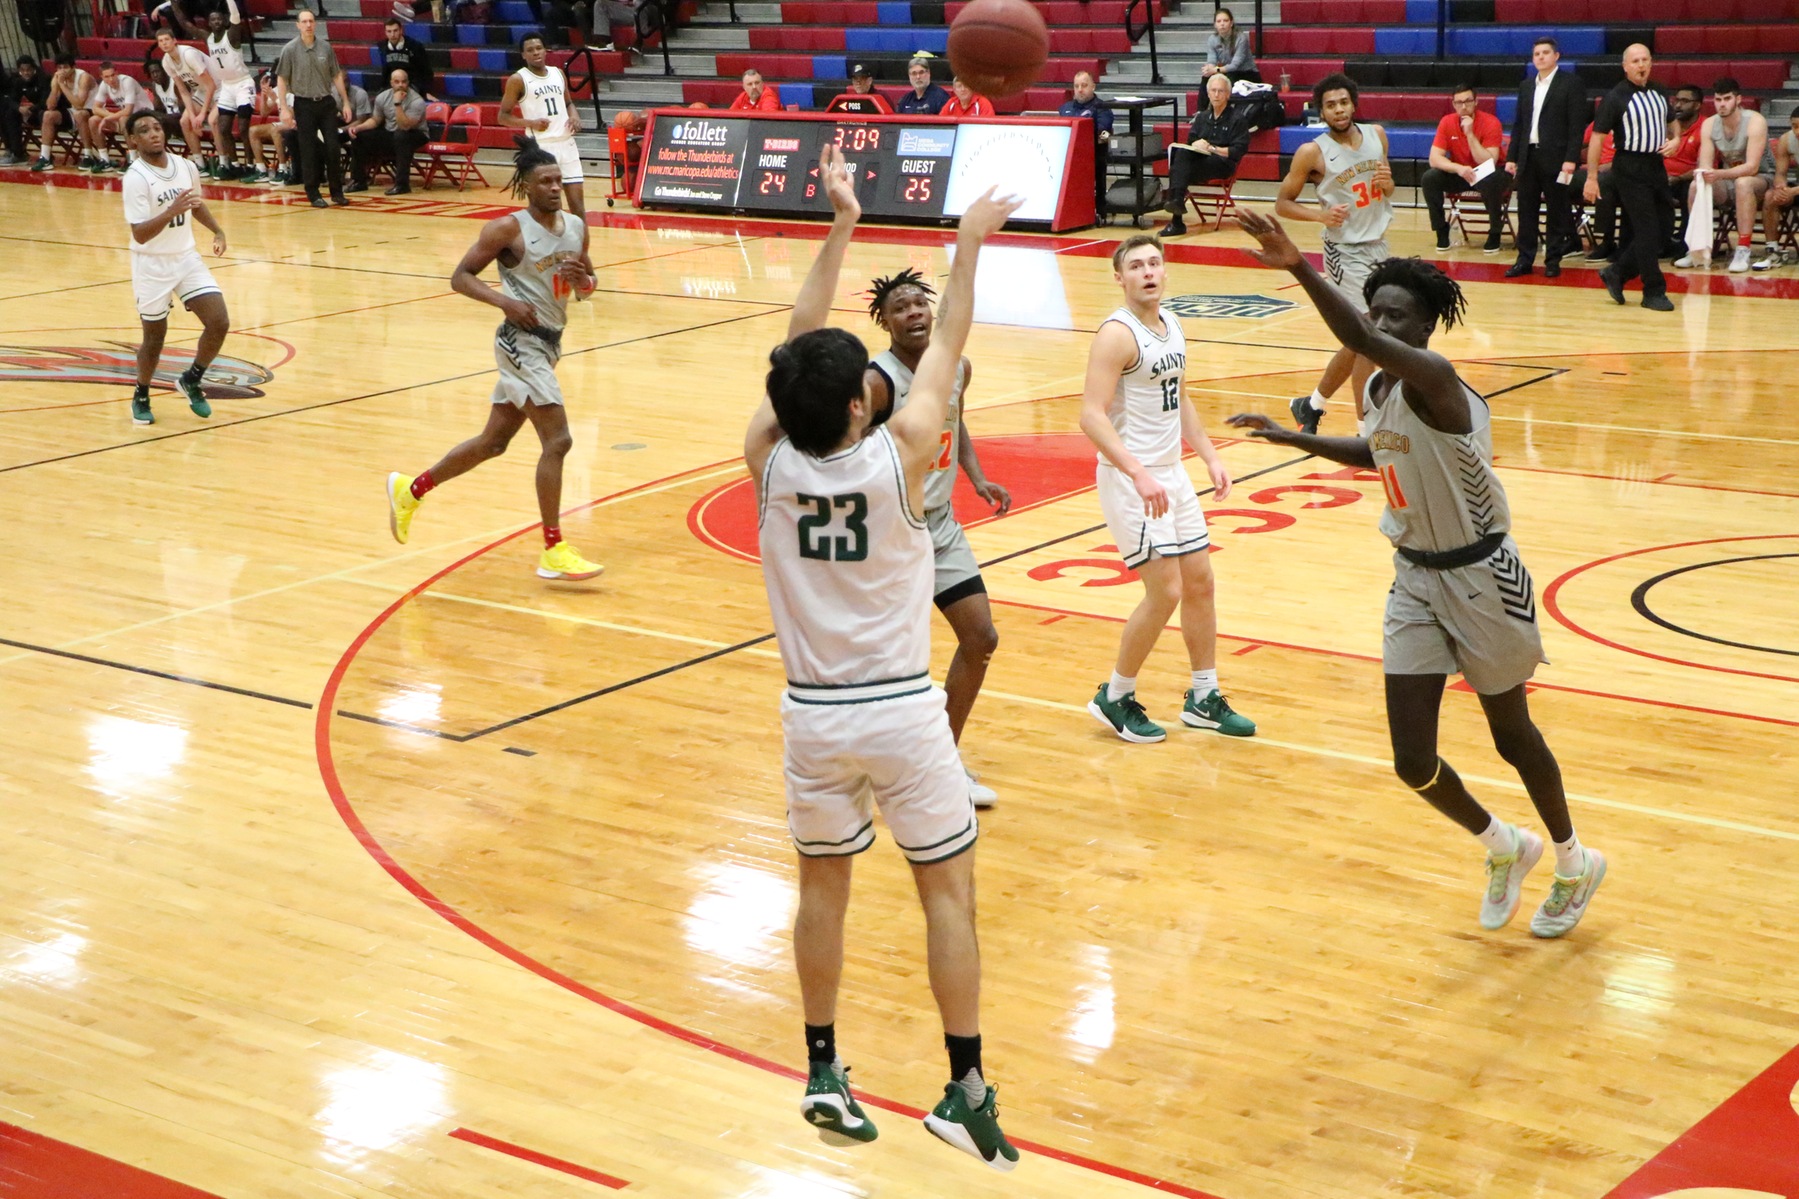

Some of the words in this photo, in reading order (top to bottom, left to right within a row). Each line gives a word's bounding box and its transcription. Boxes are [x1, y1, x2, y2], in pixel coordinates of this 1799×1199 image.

[534, 84, 562, 99] SAINTS
[545, 98, 558, 116] 11
[848, 102, 861, 110] POSS
[682, 121, 728, 141] follett
[834, 128, 880, 150] 3:09
[658, 148, 676, 161] follow
[676, 149, 687, 161] the
[688, 149, 726, 164] Thunderbirds
[726, 154, 734, 164] at
[758, 154, 788, 168] HOME
[647, 164, 739, 179] www.mc.maricopa.edu/athletics
[901, 160, 936, 173] GUEST
[654, 186, 661, 196] Go
[760, 172, 786, 194] 24
[904, 178, 931, 201] 25
[1351, 177, 1383, 208] 34
[157, 188, 183, 207] SAIN
[1160, 376, 1178, 412] 12
[1380, 464, 1408, 510] 11
[796, 492, 868, 561] 23
